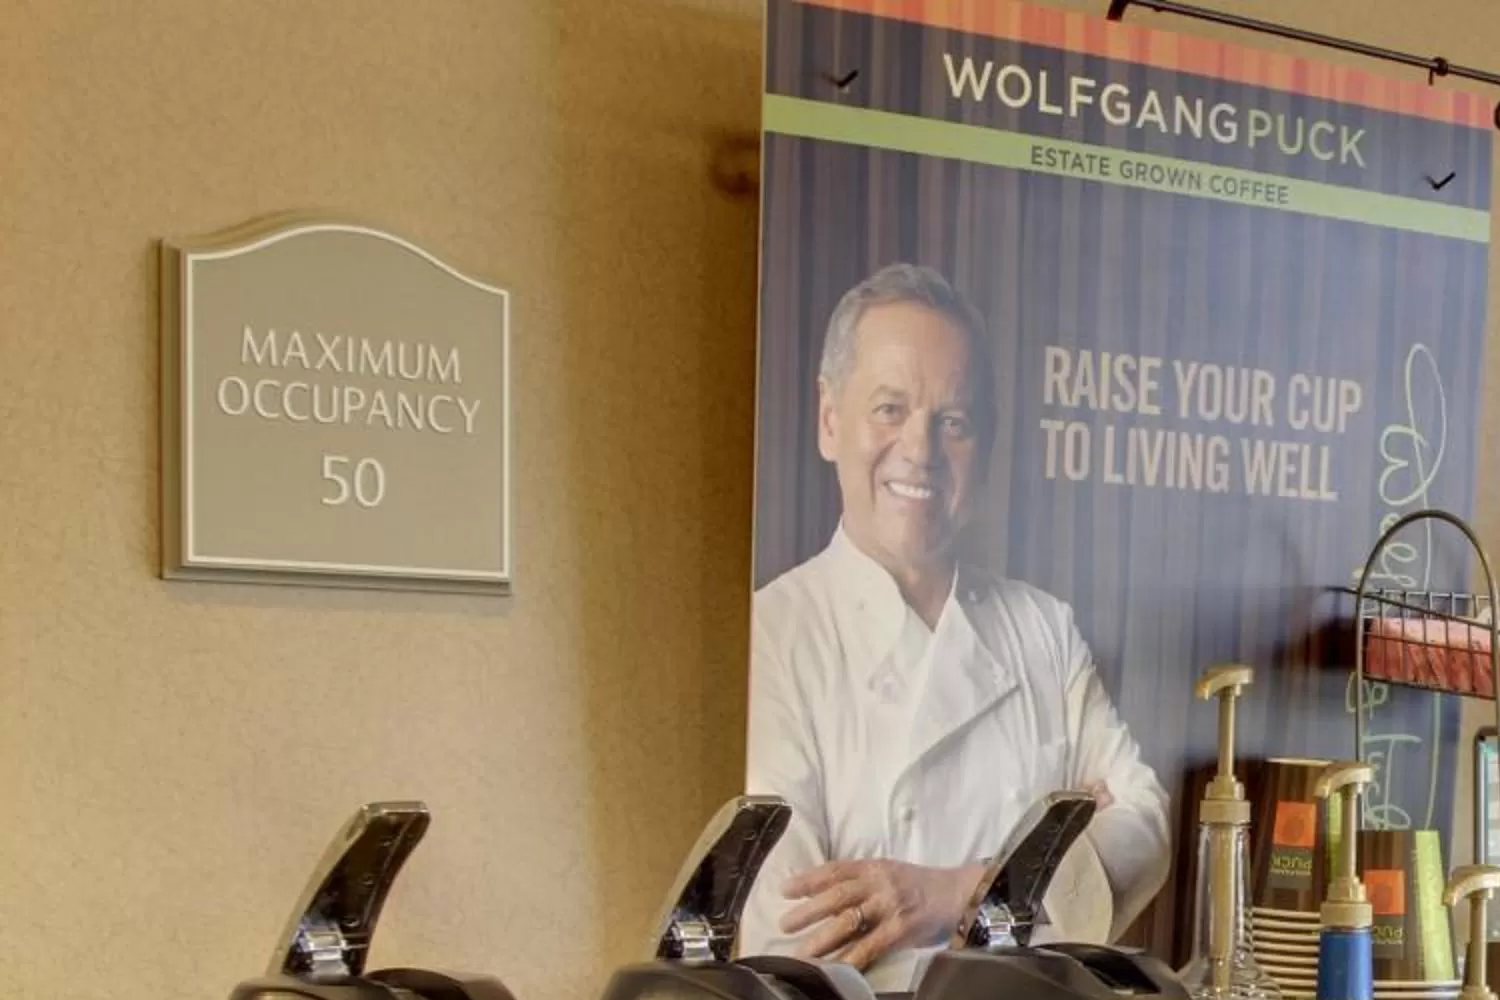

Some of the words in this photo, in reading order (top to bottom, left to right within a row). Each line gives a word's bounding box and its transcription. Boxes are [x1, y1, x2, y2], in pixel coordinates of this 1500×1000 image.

[1030, 145, 1111, 180] ESTATE
[1119, 158, 1202, 192] GROWN
[1209, 173, 1290, 205] COFFEE
[240, 325, 463, 384] MAXIMUM
[218, 375, 481, 434] OCCUPANCY
[1043, 345, 1162, 417] RAISE
[1172, 359, 1275, 428] YOUR
[1287, 372, 1363, 435] CUP
[321, 455, 385, 508] 50
[1041, 417, 1090, 482] TO
[1103, 425, 1230, 494] LIVING
[1241, 439, 1339, 502] WELL
